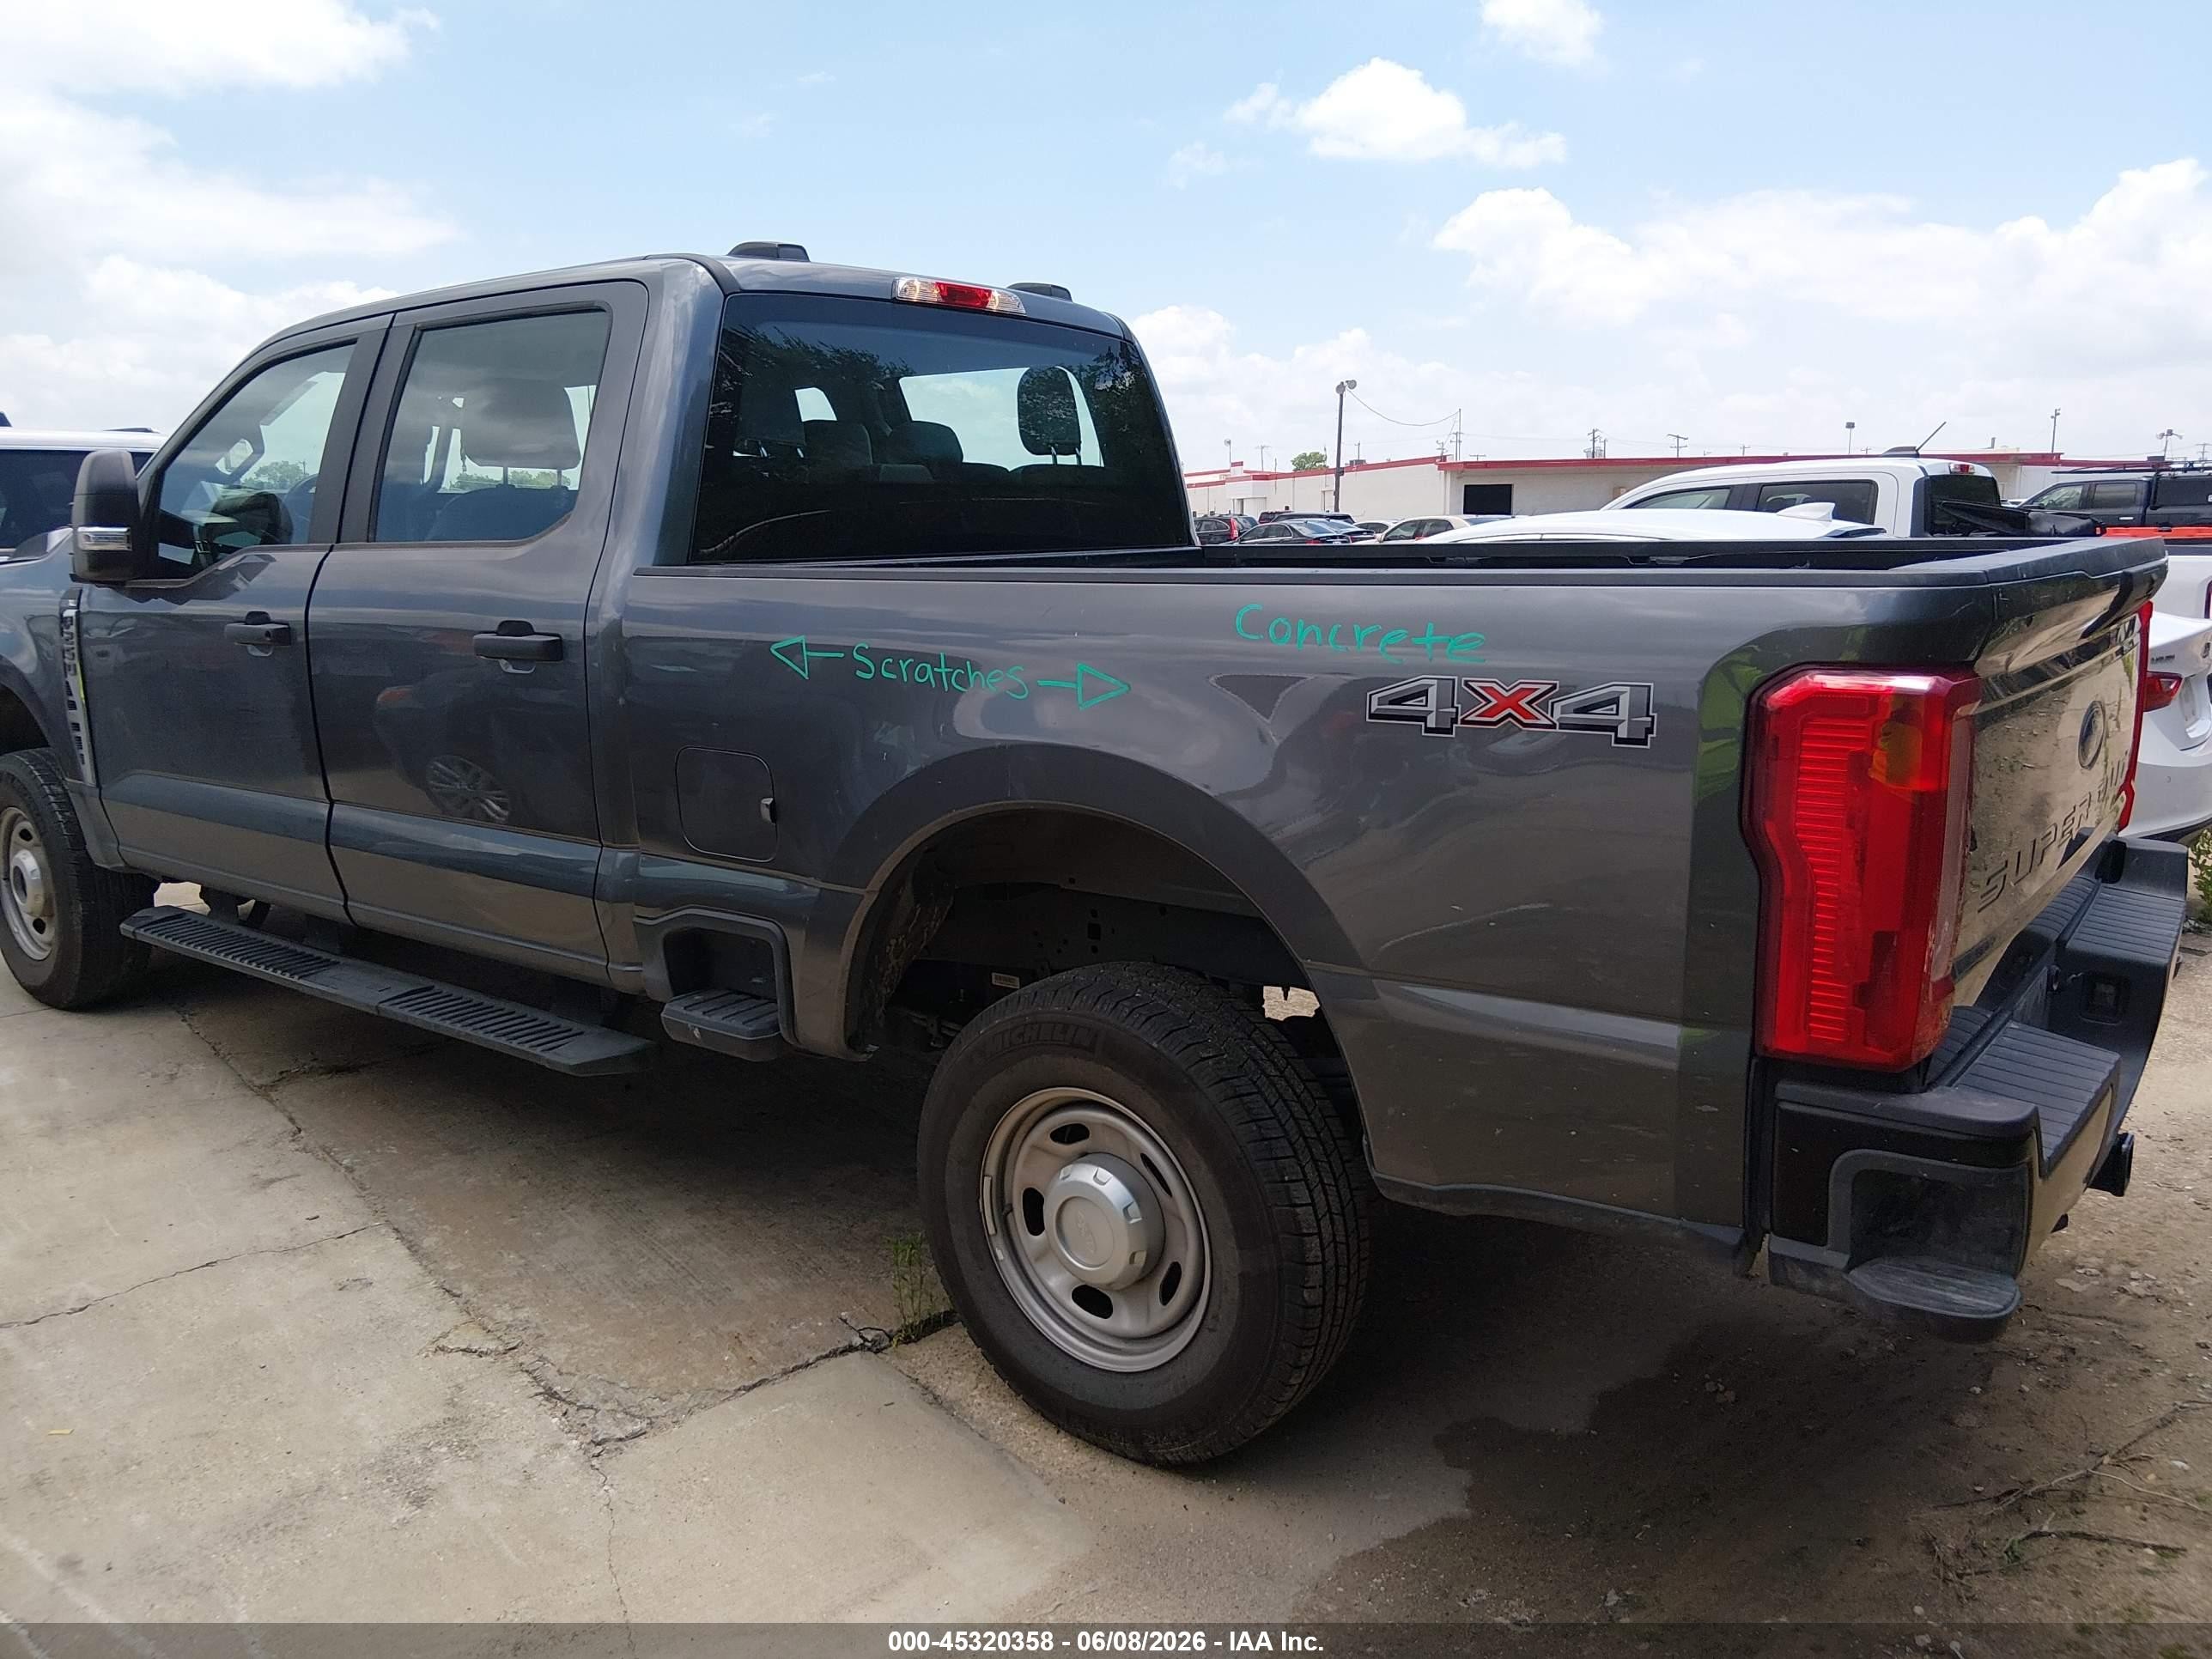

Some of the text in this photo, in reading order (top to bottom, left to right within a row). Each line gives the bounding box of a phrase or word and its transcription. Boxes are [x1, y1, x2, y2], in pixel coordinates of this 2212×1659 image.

[1235, 604, 1486, 663] Concrete
[852, 643, 1029, 700] Scratches
[1978, 792, 2093, 914] SUPER
